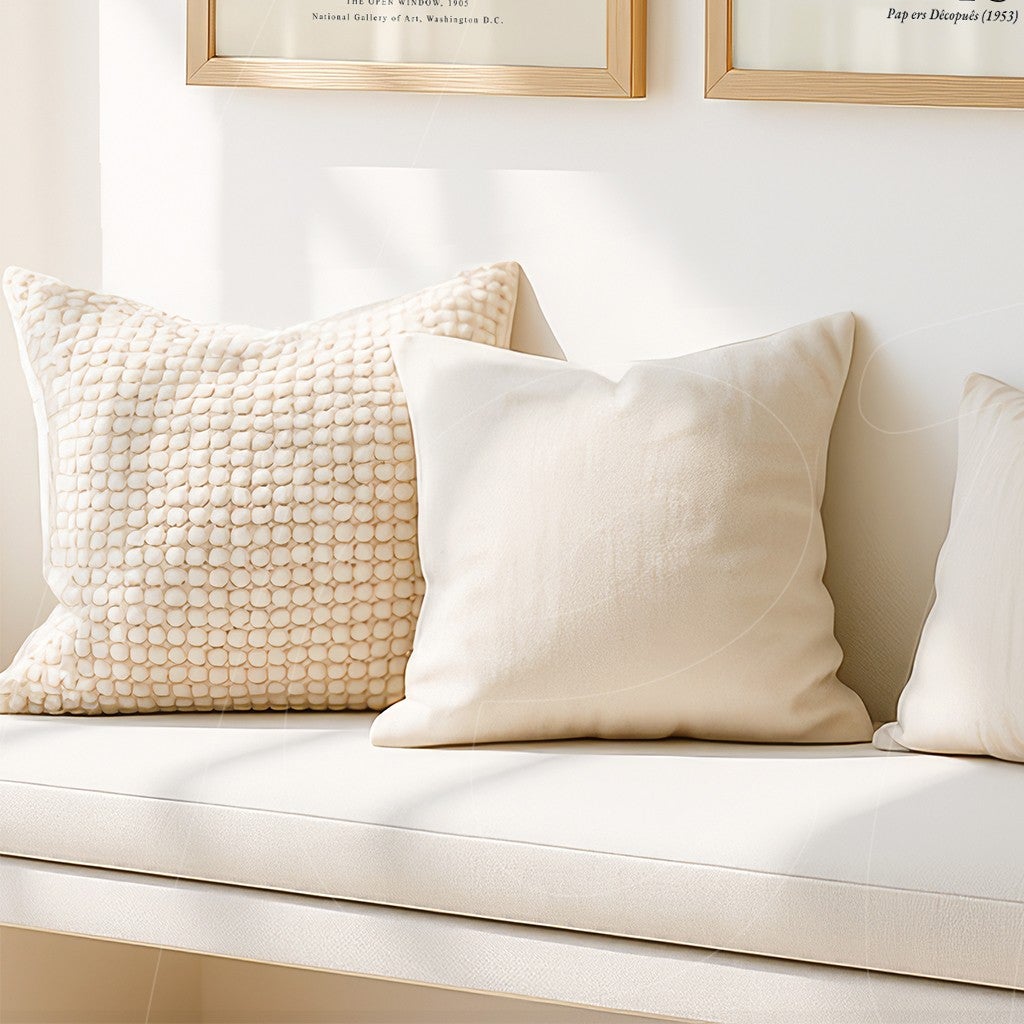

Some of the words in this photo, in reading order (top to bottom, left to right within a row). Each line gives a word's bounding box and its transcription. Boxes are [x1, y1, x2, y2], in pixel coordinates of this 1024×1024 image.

[311, 12, 351, 22] National
[353, 13, 388, 23] Gallery
[390, 14, 402, 22] of
[404, 14, 424, 23] Art,
[426, 14, 479, 26] Washington
[482, 16, 505, 25] D.C.
[980, 8, 1019, 25] (1953)
